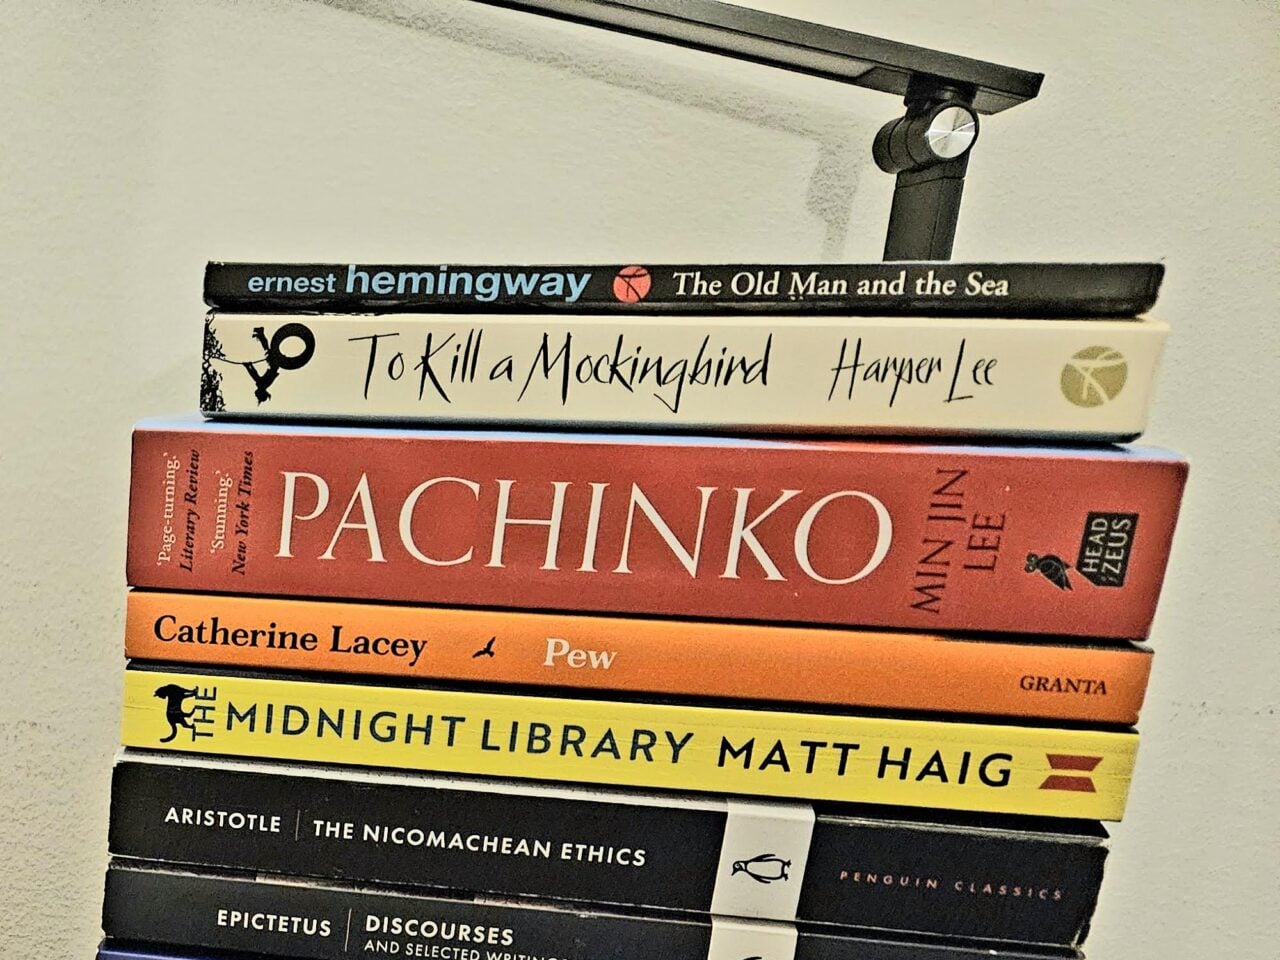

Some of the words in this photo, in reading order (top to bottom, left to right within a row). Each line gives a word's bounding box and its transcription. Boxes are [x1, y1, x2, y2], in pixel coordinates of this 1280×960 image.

[247, 272, 336, 295] ernest
[345, 264, 592, 302] hemingway
[673, 272, 722, 296] The
[731, 272, 778, 295] Old
[789, 274, 848, 297] Man
[856, 272, 907, 296] and
[915, 273, 957, 296] the
[964, 274, 1009, 297] Sea
[348, 331, 405, 400] To
[415, 328, 484, 403] Kill
[489, 356, 513, 382] a
[517, 331, 773, 413] Mockingbird
[827, 337, 943, 408] Harper
[943, 337, 999, 403] Lee
[184, 449, 200, 505] Review
[238, 451, 254, 496] Times
[927, 468, 969, 522] JIN
[180, 509, 200, 573] Literary
[235, 502, 250, 536] York
[274, 470, 893, 586] PACHINKO
[963, 512, 1006, 571] LEE
[232, 541, 247, 575] New
[1081, 518, 1109, 573] HEAD
[1102, 518, 1132, 575] ZEUS
[909, 538, 954, 614] MIN
[153, 615, 318, 652] Catherine
[329, 626, 428, 660] Lacey
[543, 638, 618, 669] Pew
[1020, 675, 1107, 696] GRANTA
[192, 686, 217, 742] THE
[226, 701, 466, 748] MIDNIGHT
[480, 718, 694, 763] LIBRARY
[718, 736, 861, 776] MATT
[877, 745, 1013, 788] HAIG
[165, 806, 281, 833] ARISTOTLE
[313, 819, 354, 841] THE
[363, 824, 551, 860] NICOMACHEAN
[560, 842, 647, 868] ETHICS
[840, 870, 938, 889] PENGUIN
[954, 880, 1062, 901] CLASSICS
[217, 909, 332, 937] EPICTETUS
[364, 940, 401, 955] AND
[365, 915, 515, 946] DISCOURSES
